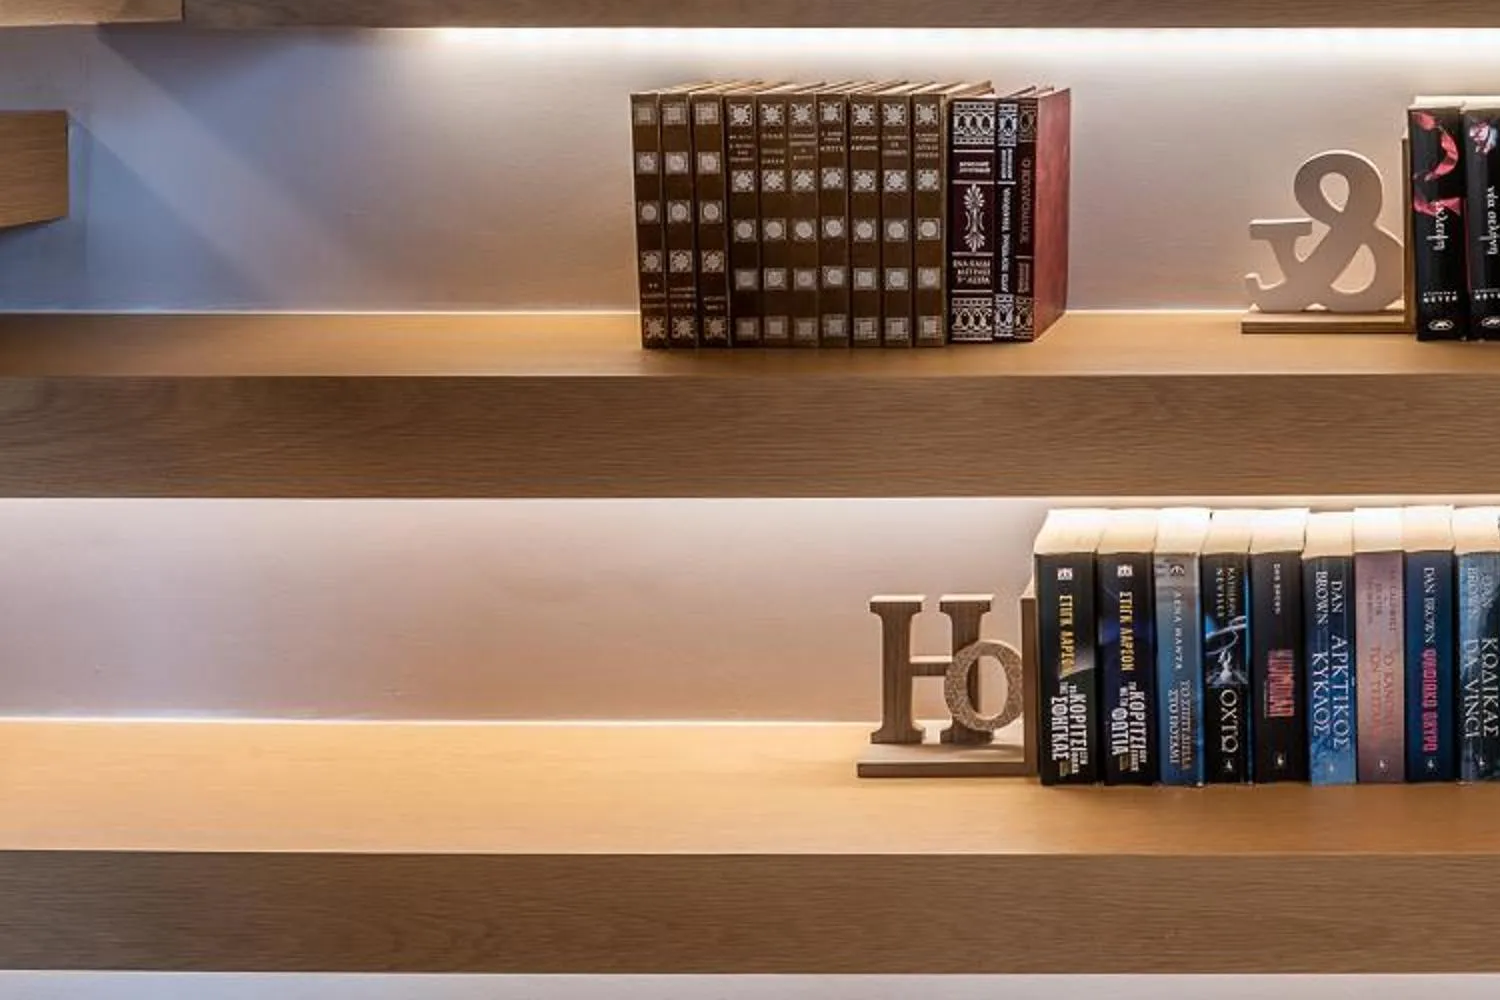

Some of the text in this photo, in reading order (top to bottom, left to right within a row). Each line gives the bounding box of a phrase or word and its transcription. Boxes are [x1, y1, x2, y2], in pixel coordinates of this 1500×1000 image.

[1058, 594, 1074, 627] ΣΤΙΓΚ
[1314, 571, 1330, 626] BROWN
[1331, 580, 1344, 614] DAN
[1422, 567, 1437, 644] DAN BROWN
[1119, 591, 1135, 672] ΣΤΙΓΚ ΛΑΡΣΟΝ
[1128, 690, 1146, 750] ΚΟΡΙΤΣΙ
[1312, 650, 1331, 737] ΚΥΚΛΟΣ
[1330, 634, 1350, 750] ΑΡΚΤΙΚΟΣ
[1462, 638, 1480, 740] DA VINCI
[1481, 637, 1500, 738] ΚΩΔΙΚΑΣ
[1050, 695, 1069, 761] ΣΦΗΓΚΑΣ
[1069, 692, 1089, 752] ΚΟΡΙΤΣΙ
[1111, 707, 1128, 756] ΦΩΤΙΑ
[1219, 689, 1240, 753] ΟΧΤΩ
